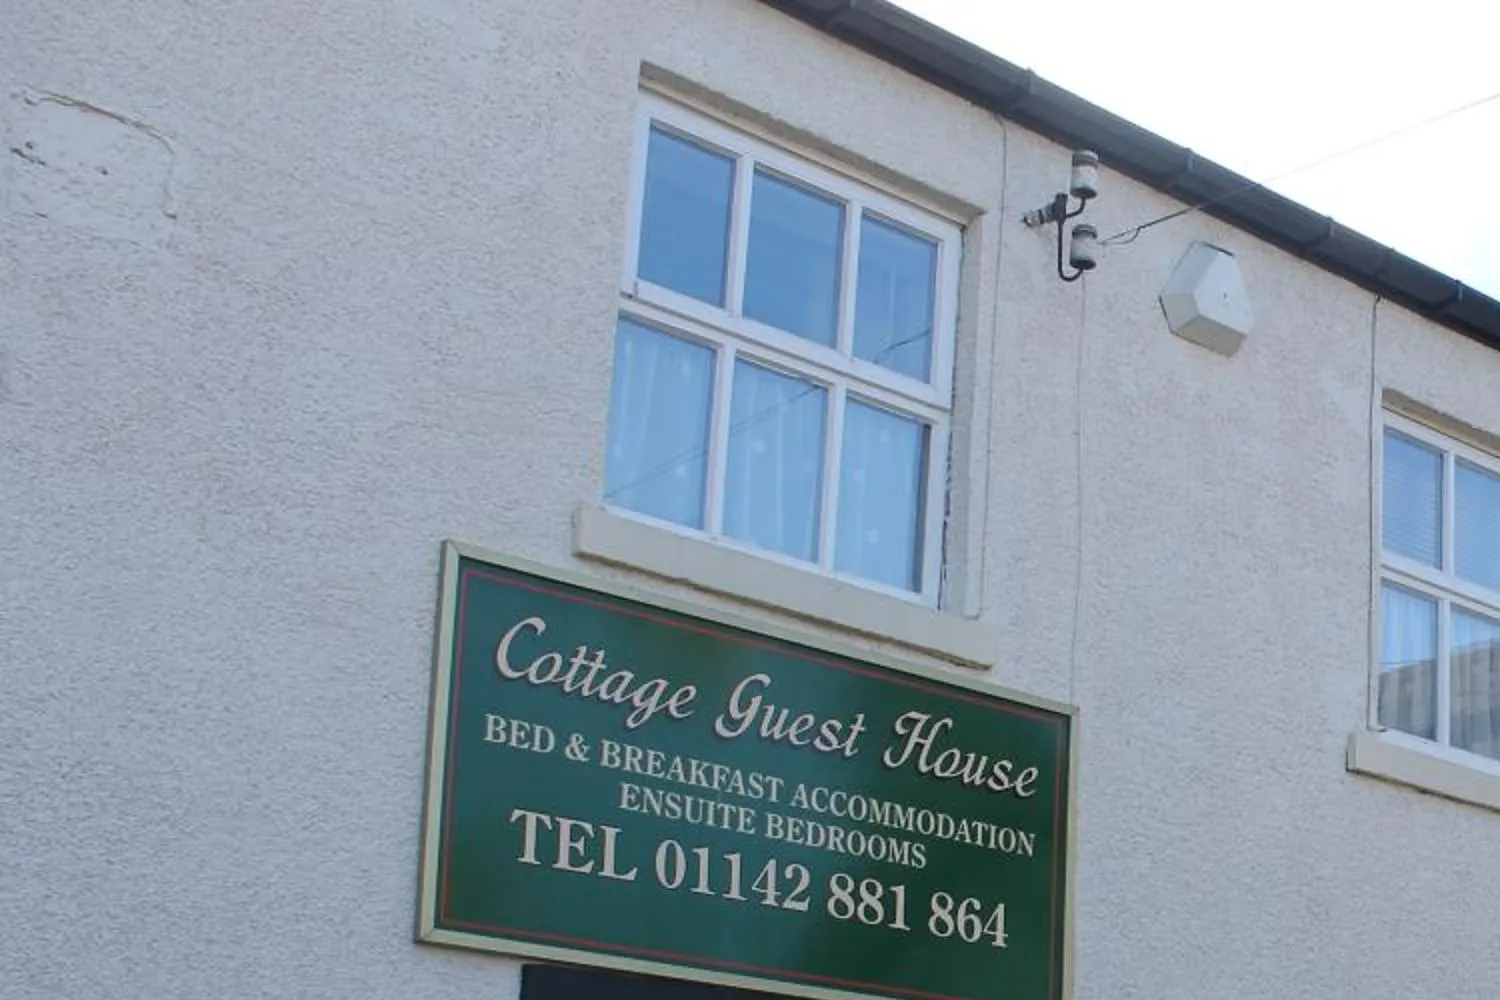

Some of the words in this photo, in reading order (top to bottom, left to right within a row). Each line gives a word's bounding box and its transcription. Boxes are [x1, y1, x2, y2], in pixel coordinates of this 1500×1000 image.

[496, 616, 698, 729] Cottage
[715, 673, 865, 757] Guest
[883, 711, 1039, 797] House
[484, 713, 555, 753] BED
[565, 733, 589, 762] &
[600, 739, 784, 802] BREAKFAST
[792, 783, 1034, 857] ACCOMMODATION
[619, 783, 755, 835] ENSUITE
[765, 815, 926, 869] BEDROOMS
[510, 809, 637, 881] TEL
[656, 840, 810, 911] 01142
[826, 873, 911, 931] 881
[928, 892, 1009, 948] 864
